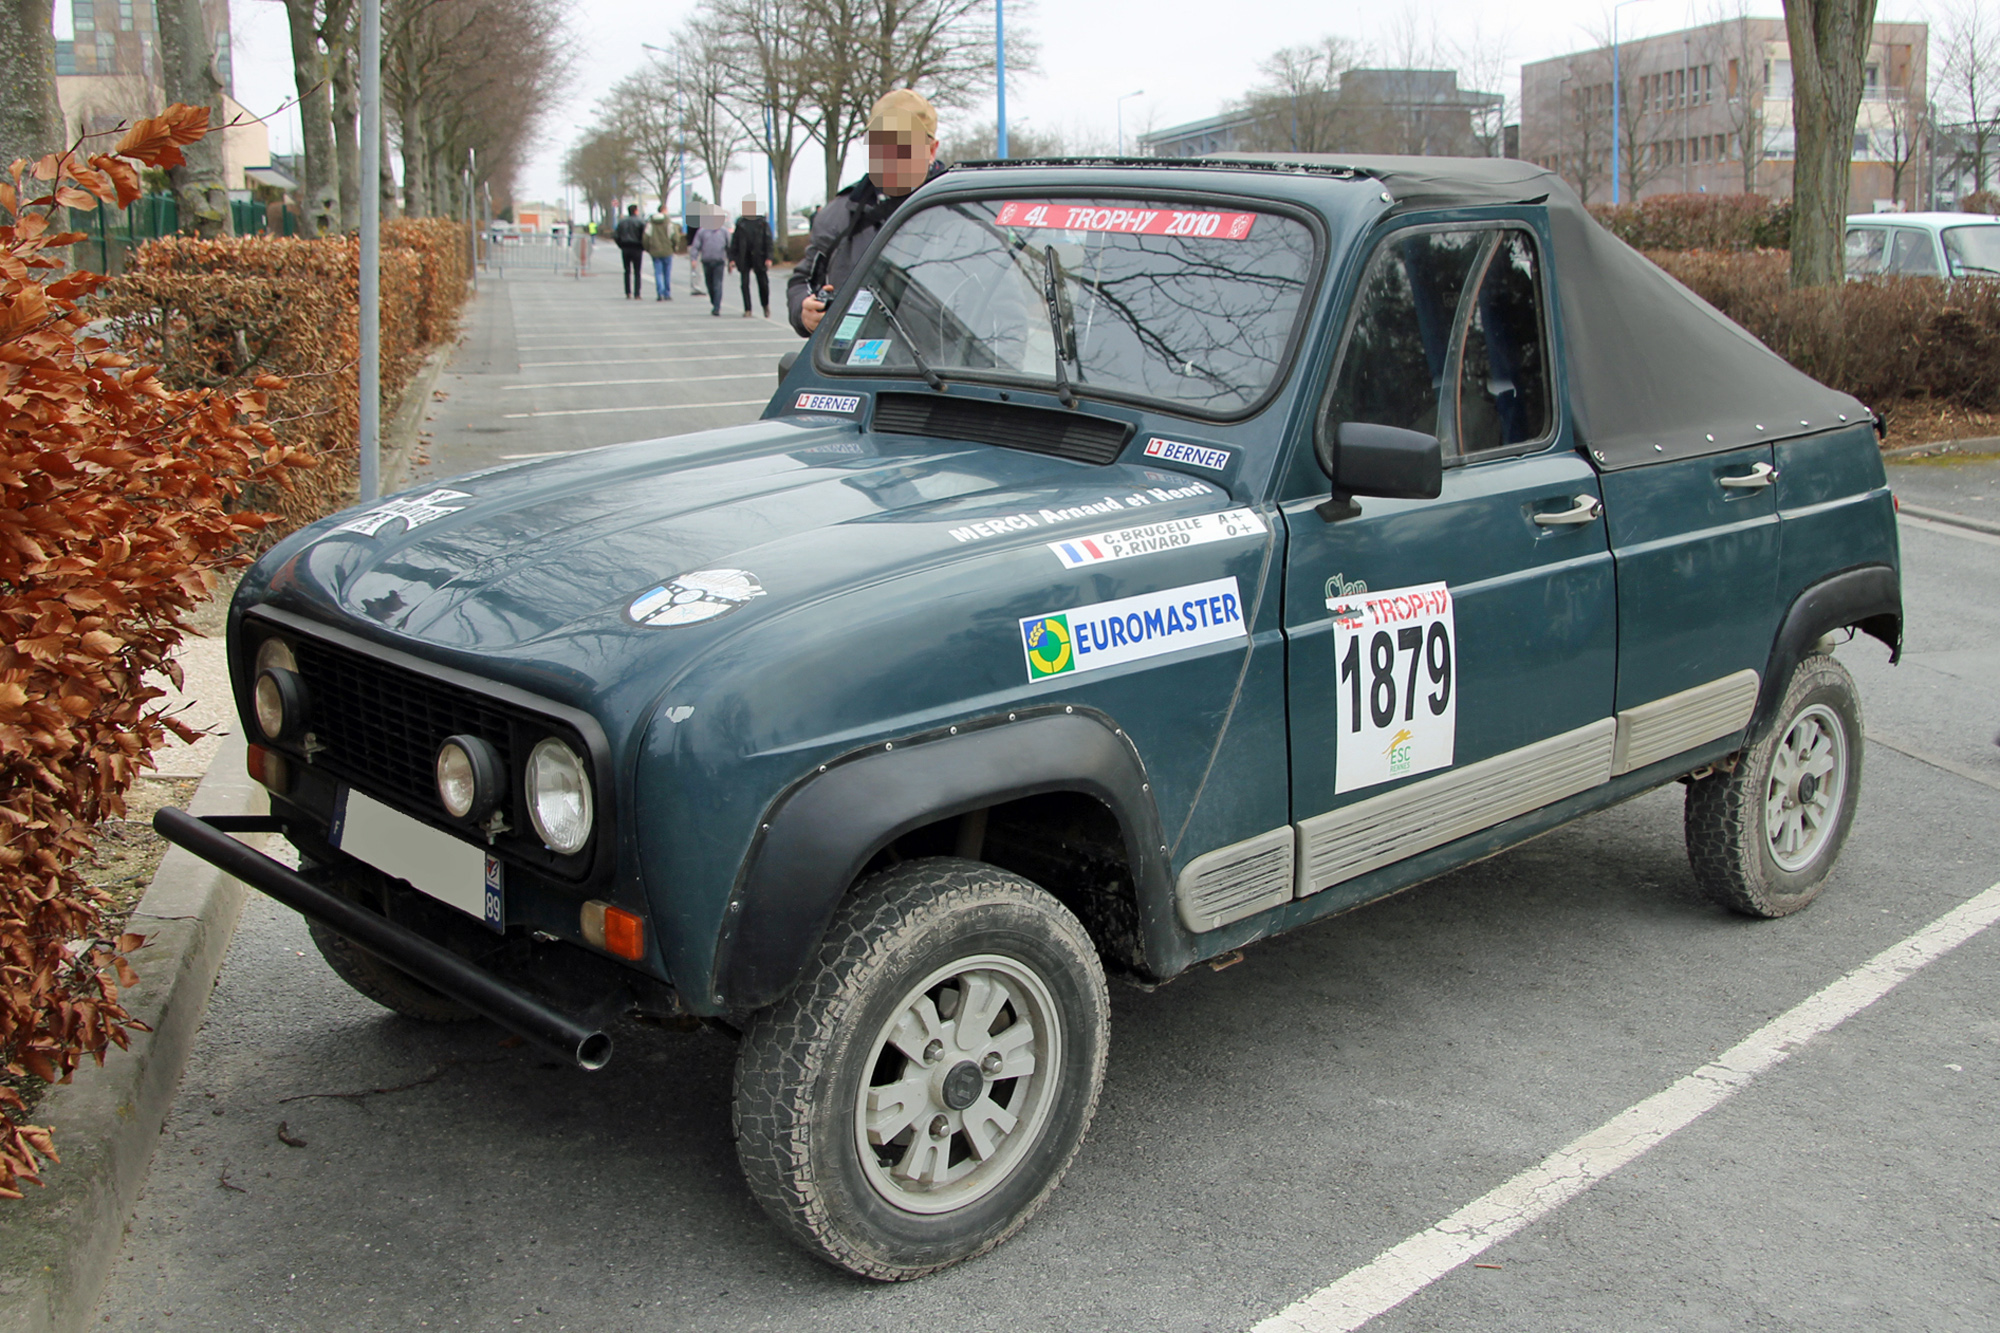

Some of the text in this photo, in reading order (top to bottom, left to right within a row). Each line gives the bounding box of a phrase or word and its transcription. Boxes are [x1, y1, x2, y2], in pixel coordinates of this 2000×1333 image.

[1023, 205, 1221, 237] 4L TROPHY 2010
[810, 395, 858, 411] BERNER
[1163, 443, 1227, 469] BERNER
[948, 481, 1213, 543] MERCI Arnaud et Henri
[1365, 589, 1447, 625] TROPHY
[1074, 592, 1240, 655] EUROMASTER
[1341, 620, 1451, 733] 1879
[1391, 745, 1411, 764] ESC
[486, 892, 501, 922] 89
